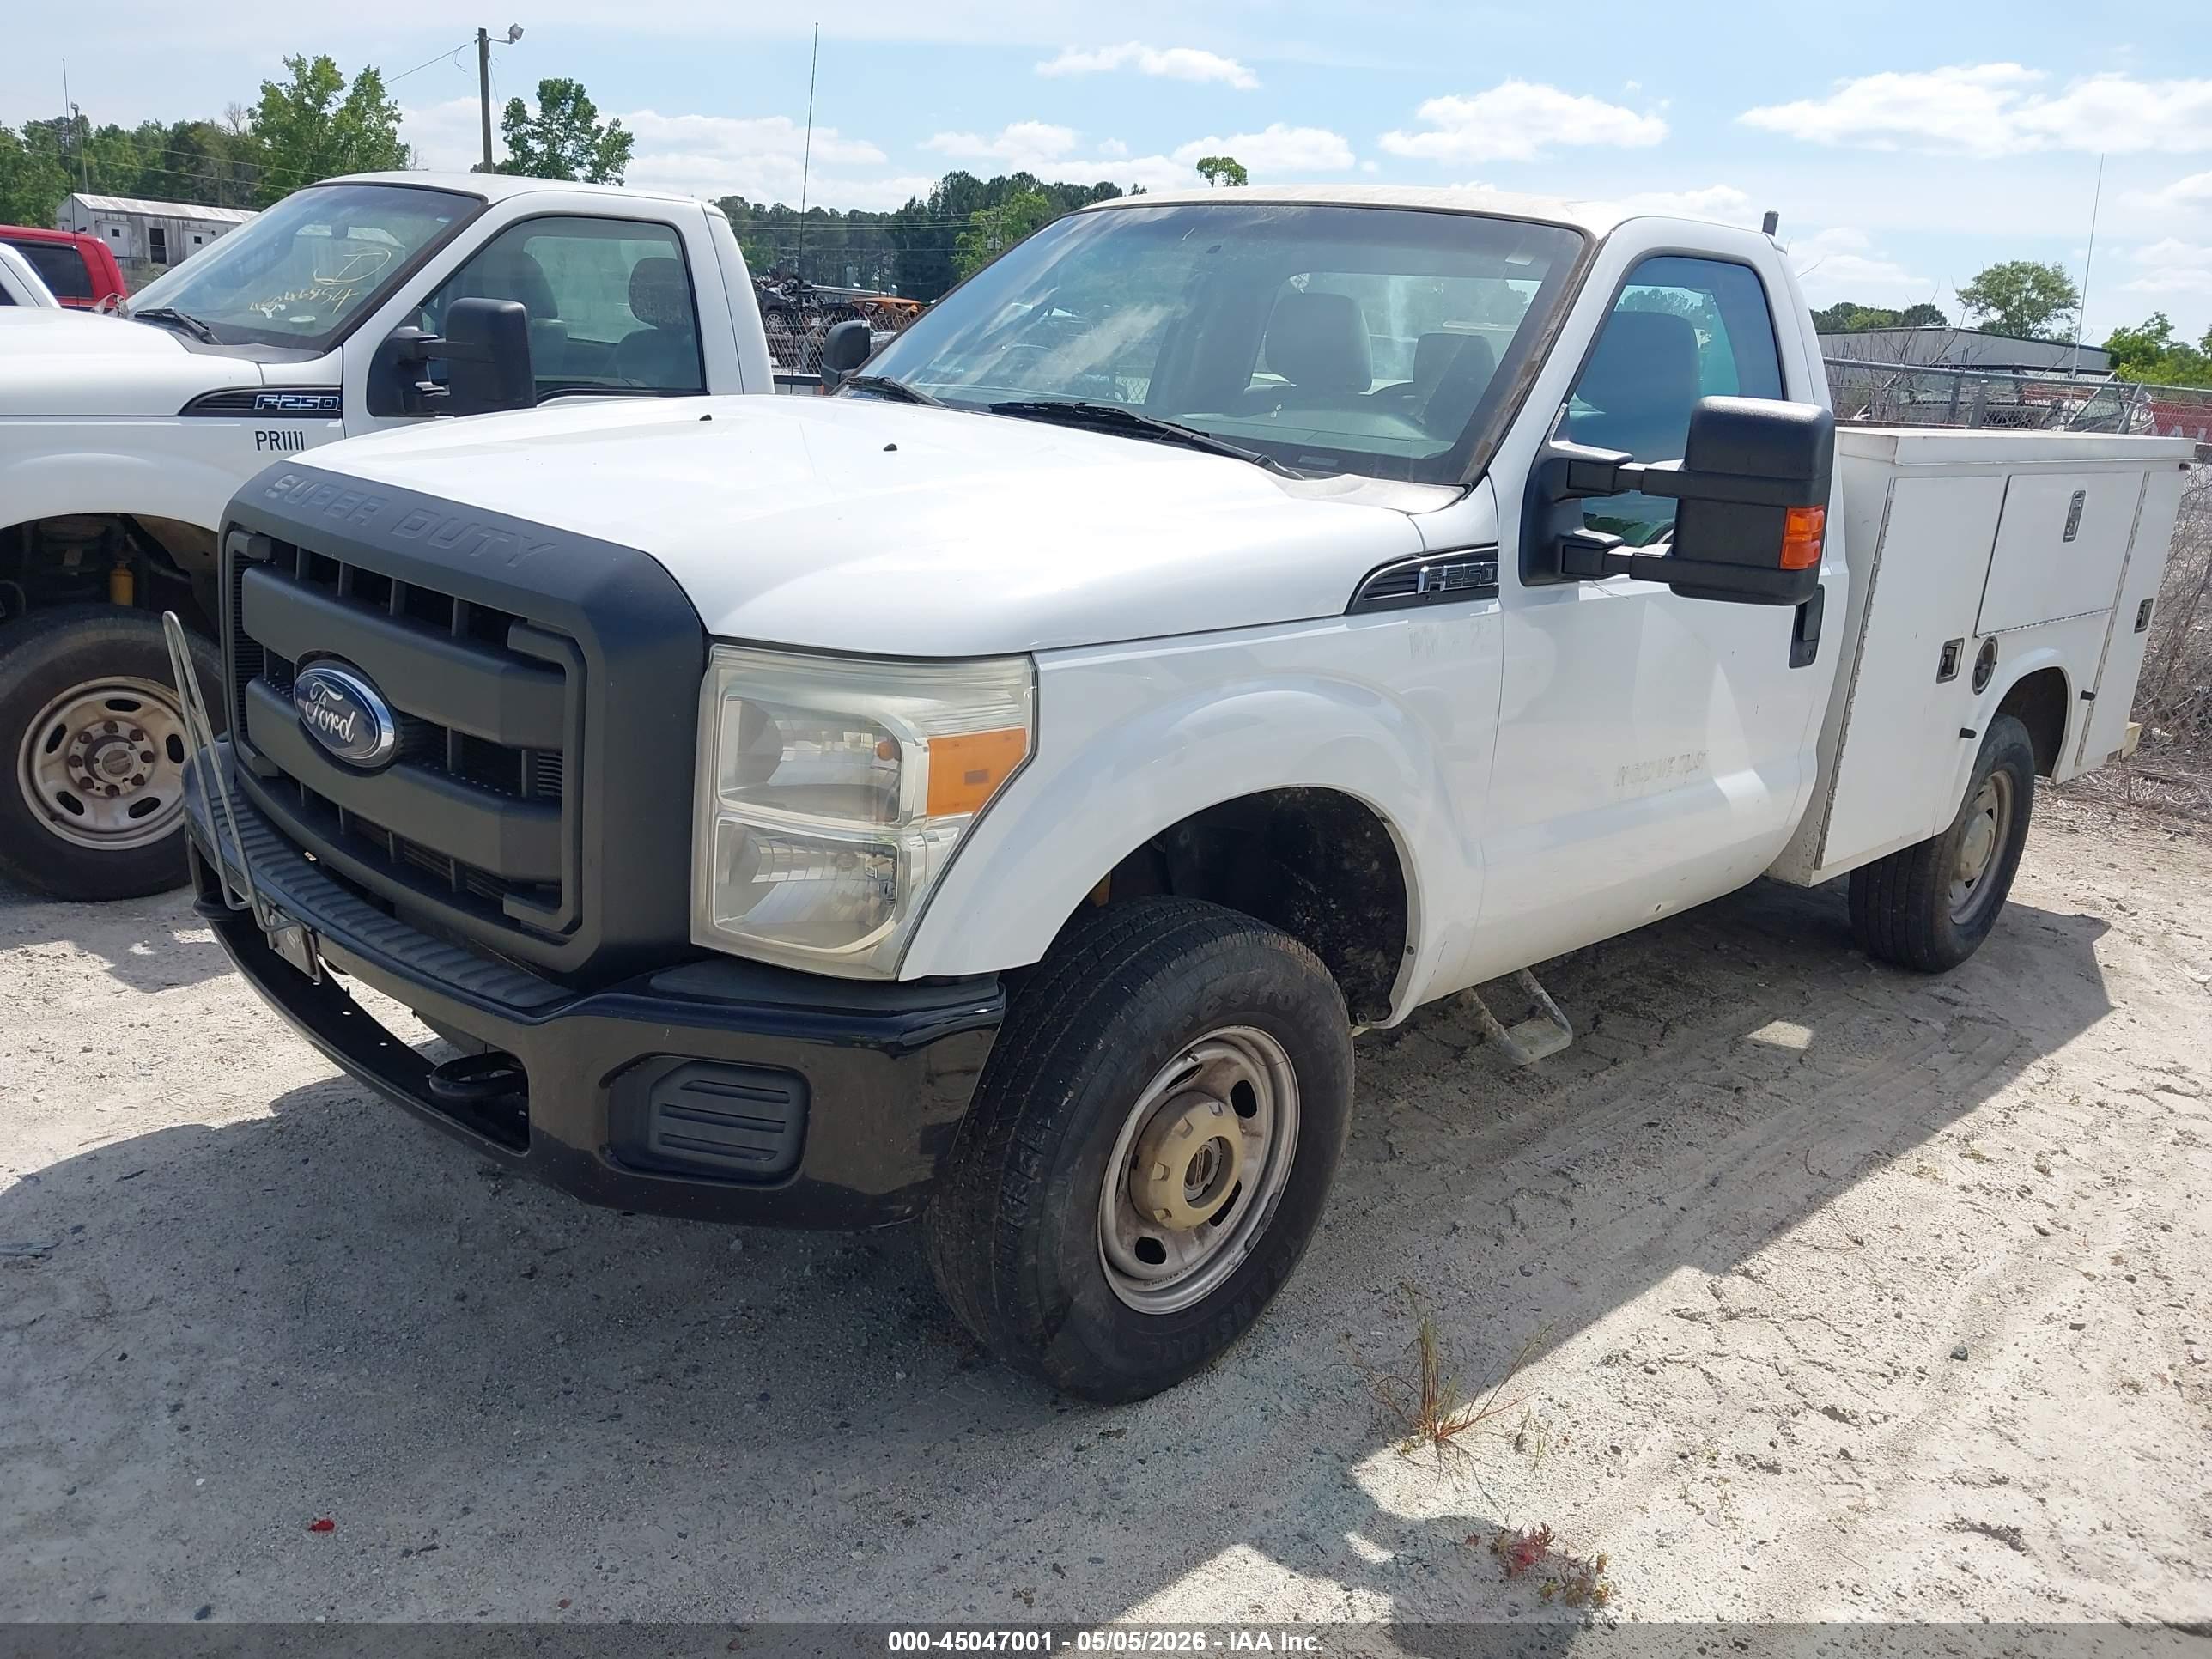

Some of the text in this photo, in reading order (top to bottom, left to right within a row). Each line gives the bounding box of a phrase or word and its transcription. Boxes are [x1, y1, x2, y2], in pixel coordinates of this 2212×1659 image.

[253, 394, 340, 410] F-250
[254, 431, 306, 452] PR1111
[264, 472, 559, 568] SUPER DUTY
[1417, 561, 1498, 594] F-250
[304, 680, 357, 744] Ford
